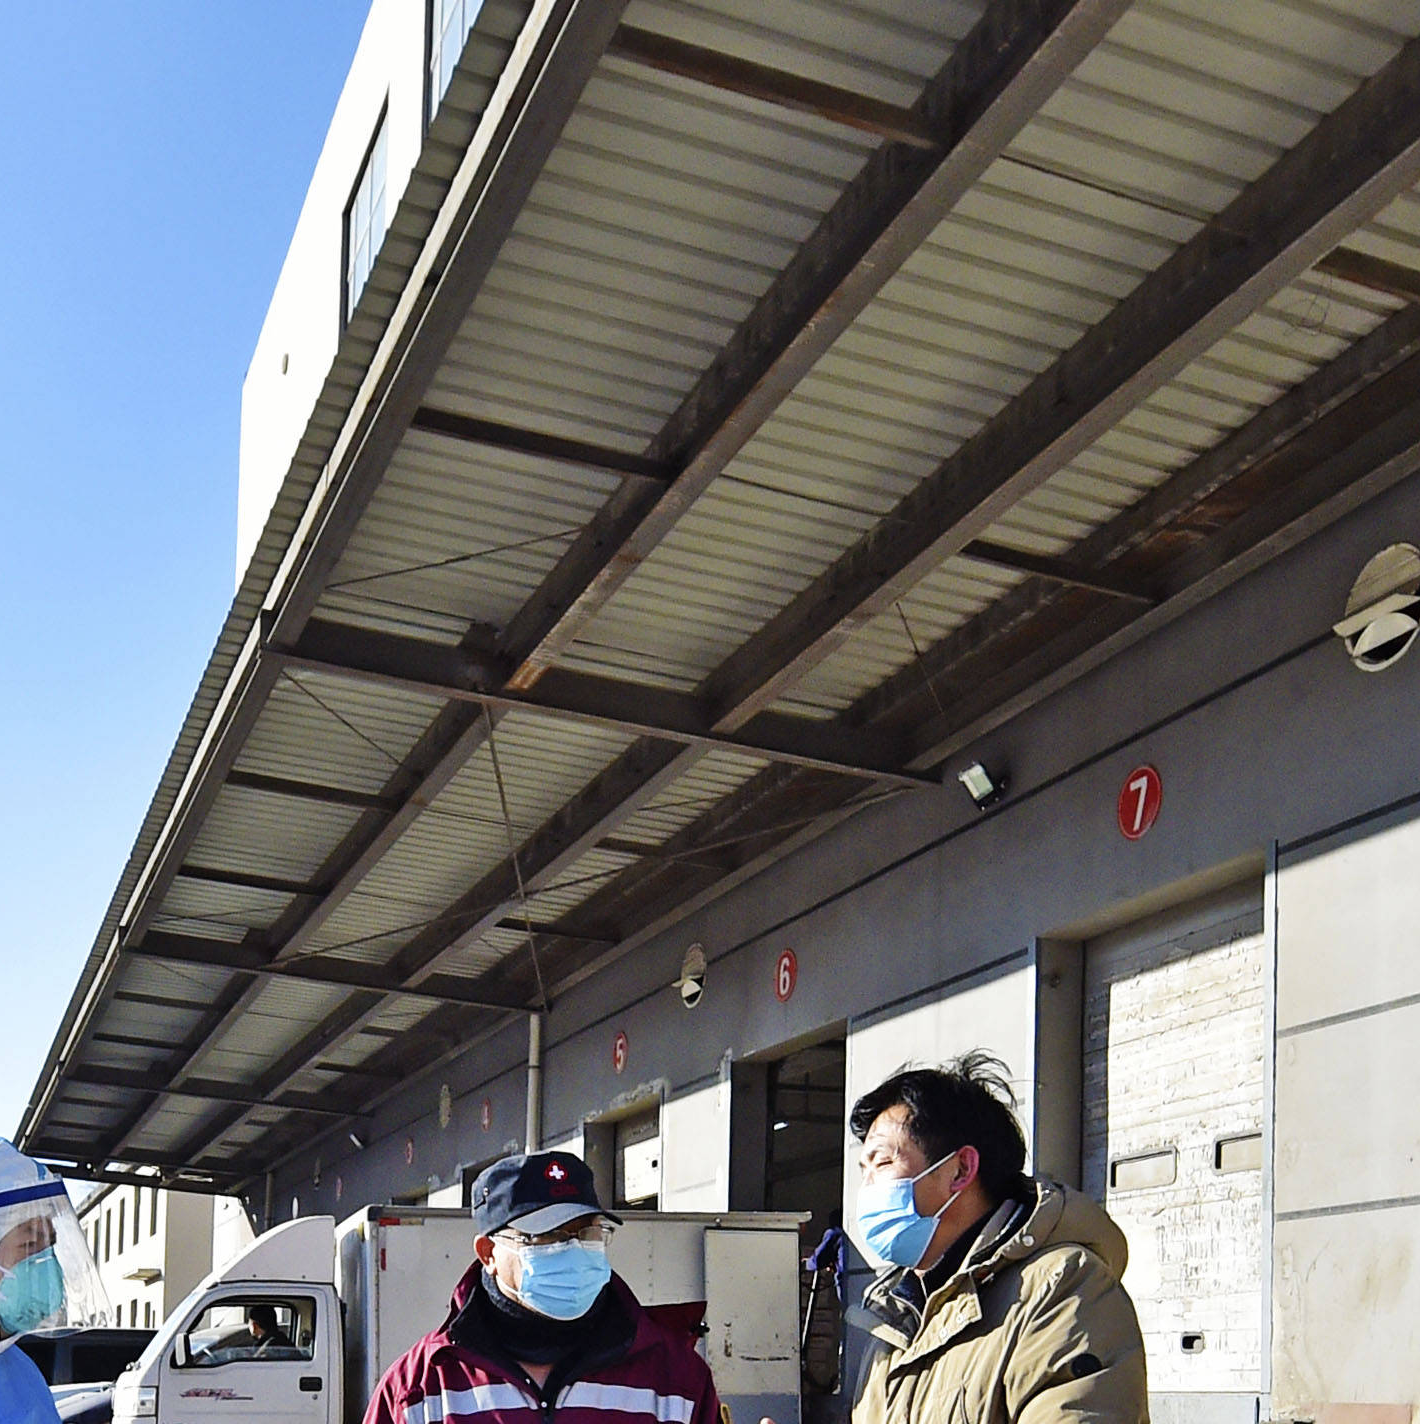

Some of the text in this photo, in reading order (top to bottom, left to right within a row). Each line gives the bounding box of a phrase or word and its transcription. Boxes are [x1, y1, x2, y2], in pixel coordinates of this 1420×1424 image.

[1129, 777, 1148, 830] 7
[779, 956, 790, 996] 6
[615, 1038, 625, 1074] 5
